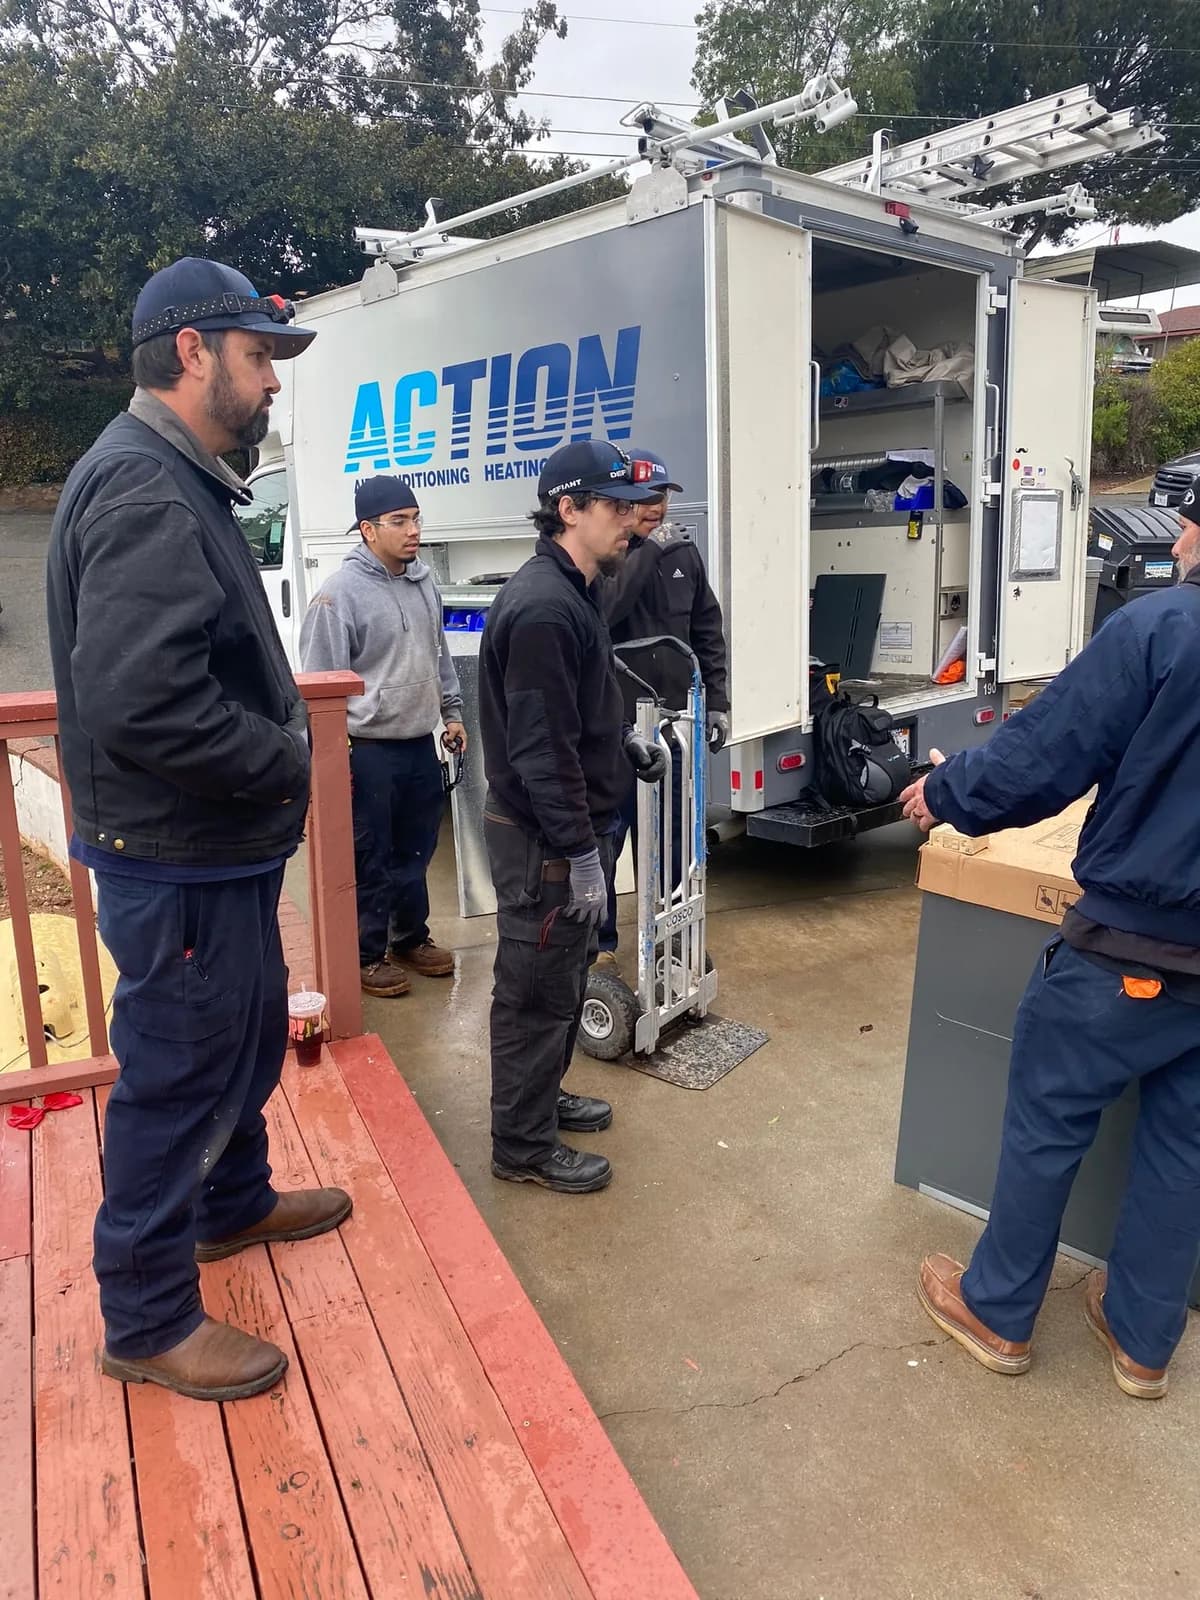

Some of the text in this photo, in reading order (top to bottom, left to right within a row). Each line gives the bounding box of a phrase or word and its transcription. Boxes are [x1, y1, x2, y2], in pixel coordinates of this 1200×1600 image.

[344, 325, 641, 473] ACTION
[547, 478, 582, 497] DEFIANT
[984, 682, 997, 695] 190
